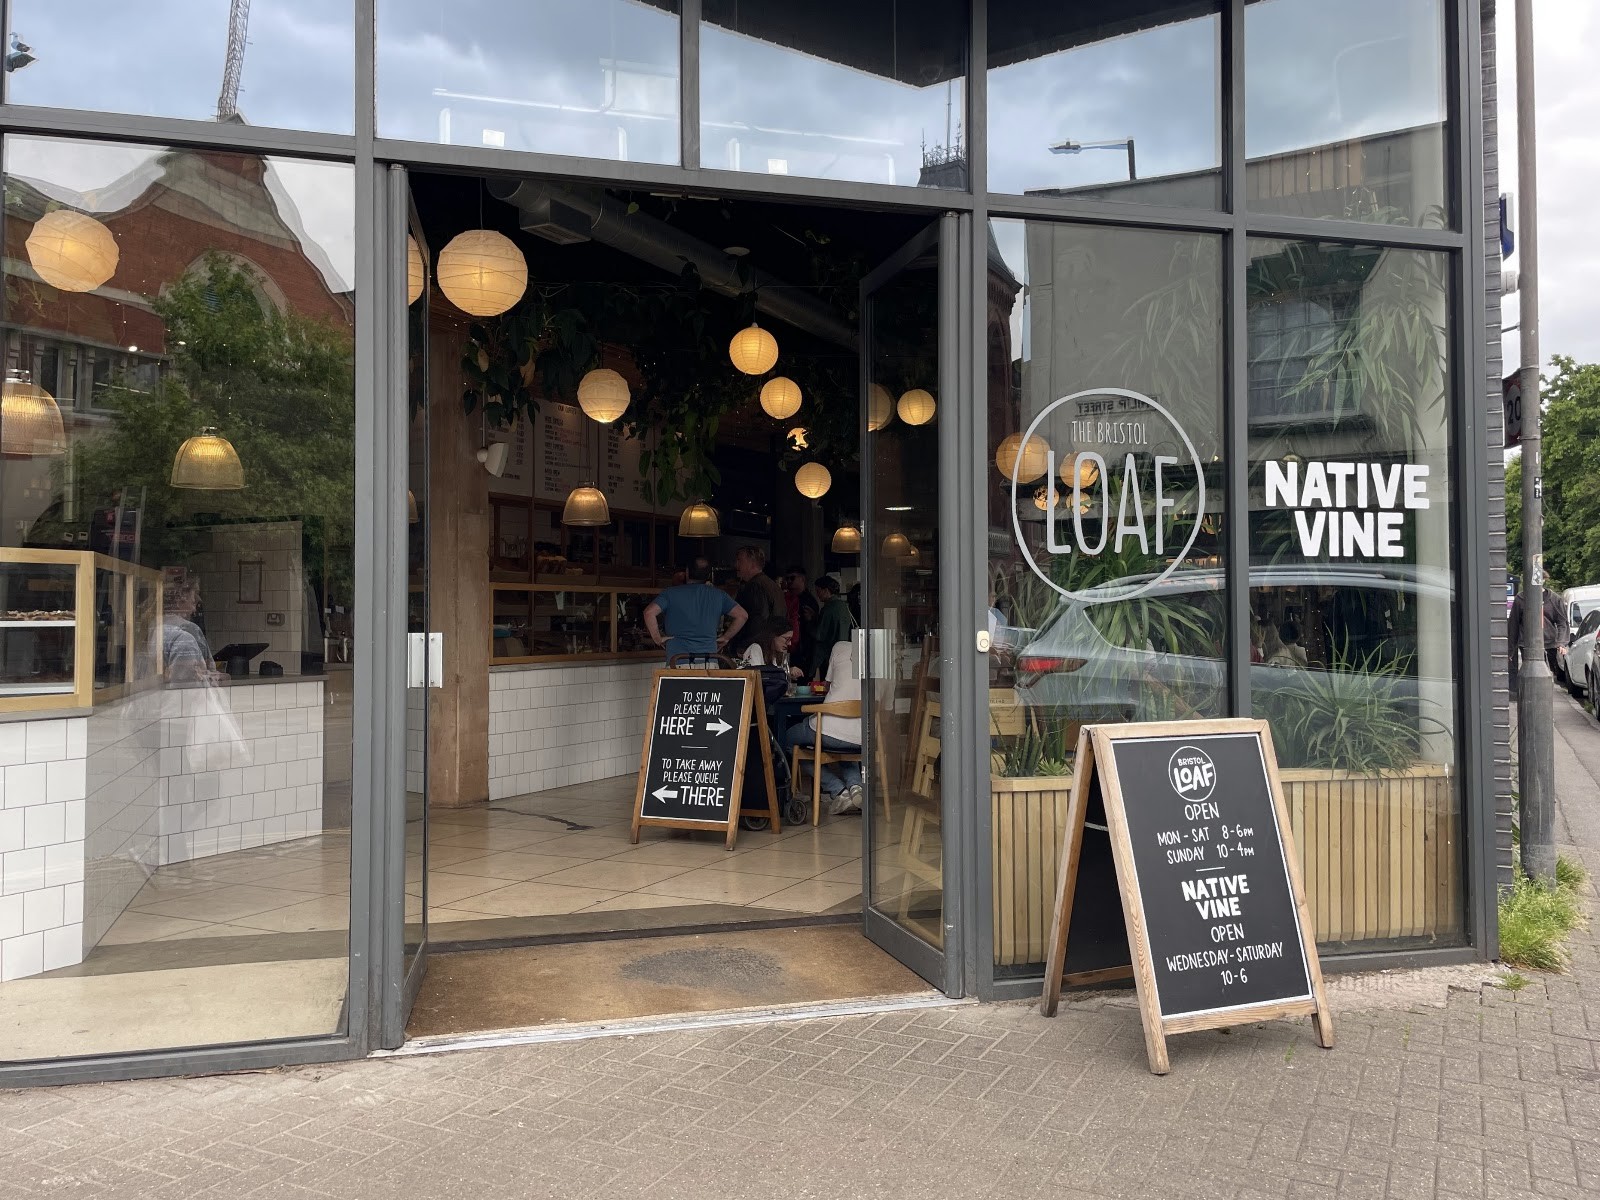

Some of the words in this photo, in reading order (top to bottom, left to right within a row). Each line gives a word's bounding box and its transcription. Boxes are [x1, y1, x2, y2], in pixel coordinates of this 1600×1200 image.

[1507, 396, 1521, 425] 20
[1072, 421, 1092, 443] THE
[1097, 421, 1148, 445] BRISTOL
[1264, 460, 1430, 510] NATIVE
[1046, 450, 1178, 556] LOAF
[1294, 510, 1404, 558] VINE
[683, 691, 692, 703] TO
[696, 691, 708, 703] SIT
[711, 692, 721, 703] IN
[674, 704, 701, 715] PLEASE
[703, 704, 723, 715] WAIT
[659, 716, 695, 736] HERE
[662, 758, 672, 770] TO
[675, 758, 697, 771] TAKE
[698, 759, 723, 771] AWAY
[1177, 757, 1206, 767] BRISTOL
[663, 771, 692, 783] PLEASE
[694, 772, 719, 785] QUEUE
[1173, 763, 1214, 793] LOAF
[680, 785, 725, 807] THERE
[1184, 801, 1220, 821] OPEN
[1156, 830, 1182, 847] MON
[1191, 826, 1210, 843] SAT
[1166, 845, 1205, 865] SUNDAY
[1181, 874, 1250, 901] NATIVE
[1195, 896, 1242, 920] VINE
[1210, 923, 1245, 943] OPEN
